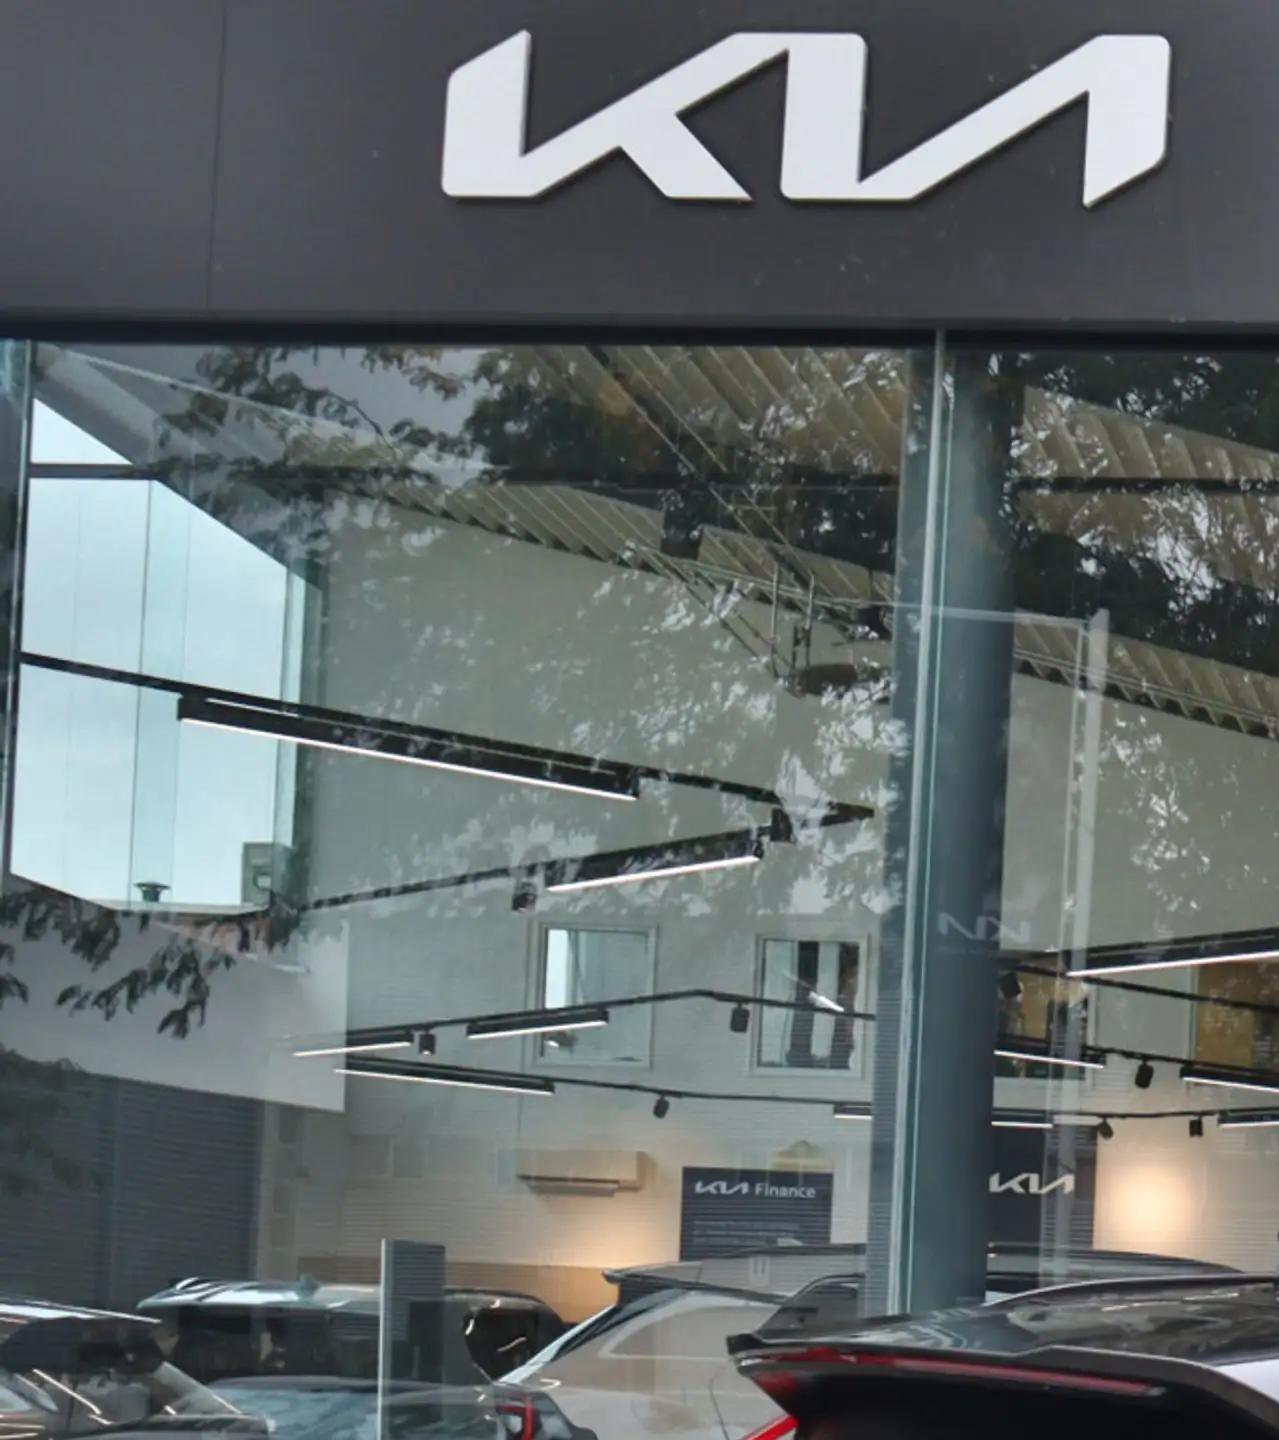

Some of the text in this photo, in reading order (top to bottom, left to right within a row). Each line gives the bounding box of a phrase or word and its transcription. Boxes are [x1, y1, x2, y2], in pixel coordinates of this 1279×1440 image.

[441, 29, 1172, 208] KIA
[694, 1180, 817, 1198] KIA Finance
[989, 1172, 1076, 1195] KIA
